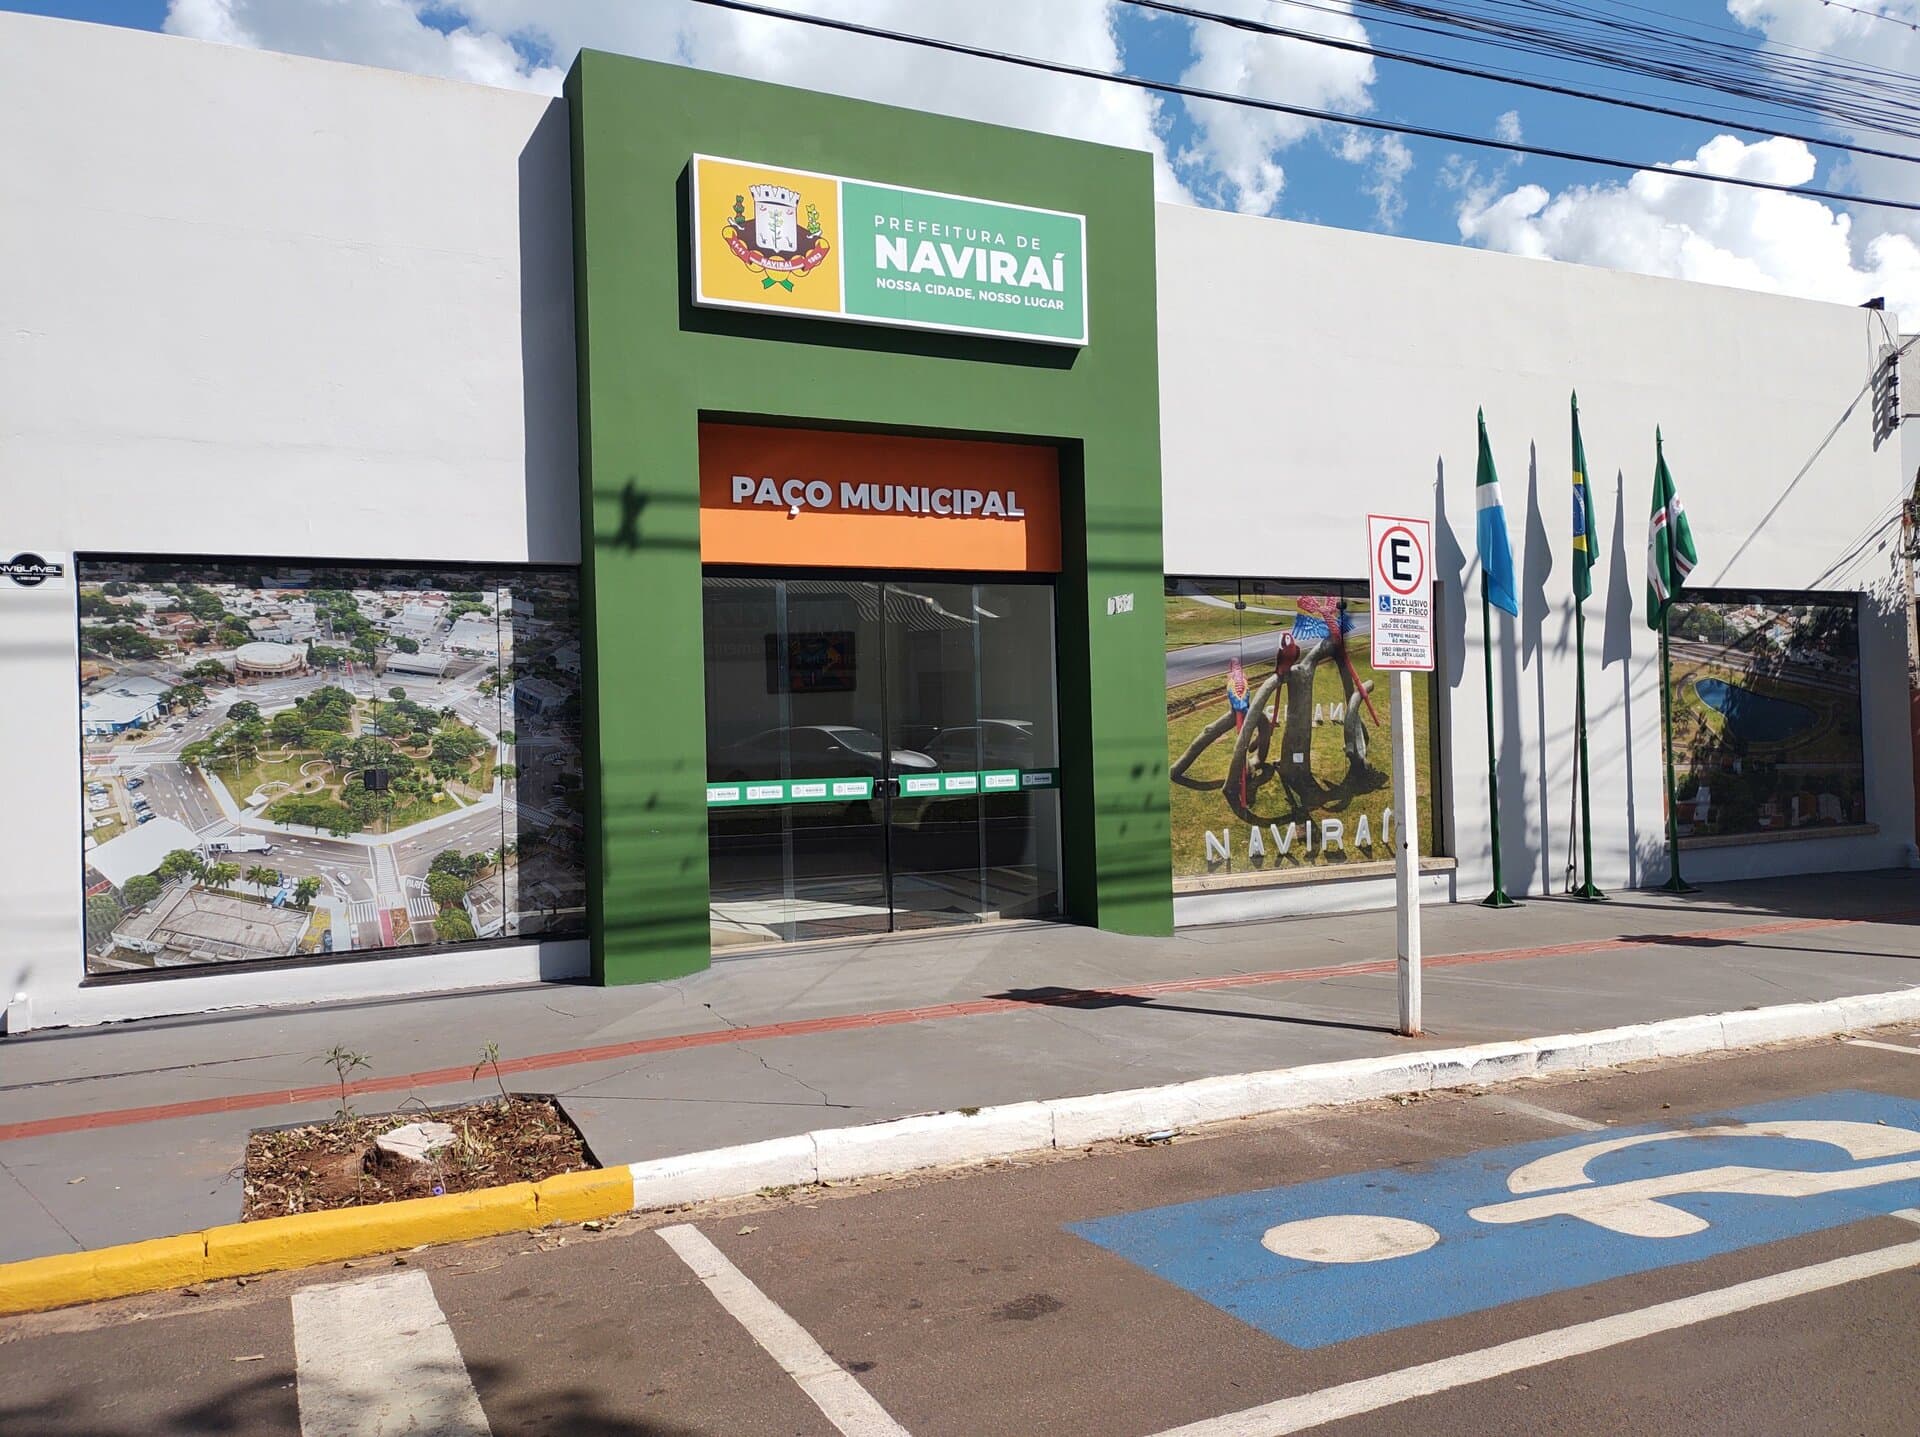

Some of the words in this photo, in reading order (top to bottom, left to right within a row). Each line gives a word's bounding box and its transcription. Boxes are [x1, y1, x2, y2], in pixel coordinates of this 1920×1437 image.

[874, 215, 1006, 246] PREFEITURA
[1016, 235, 1041, 250] DE
[875, 234, 1065, 292] NAVIRAÍ
[876, 277, 922, 294] NOSSA
[925, 283, 976, 301] CIDADE,
[979, 290, 1022, 305] NOSSO
[1024, 296, 1065, 311] LUGAR
[731, 475, 832, 516] PAÇO
[840, 482, 1025, 517] MUNICIPAL
[1391, 538, 1412, 581] E
[1392, 598, 1428, 608] EXCLUSIVO
